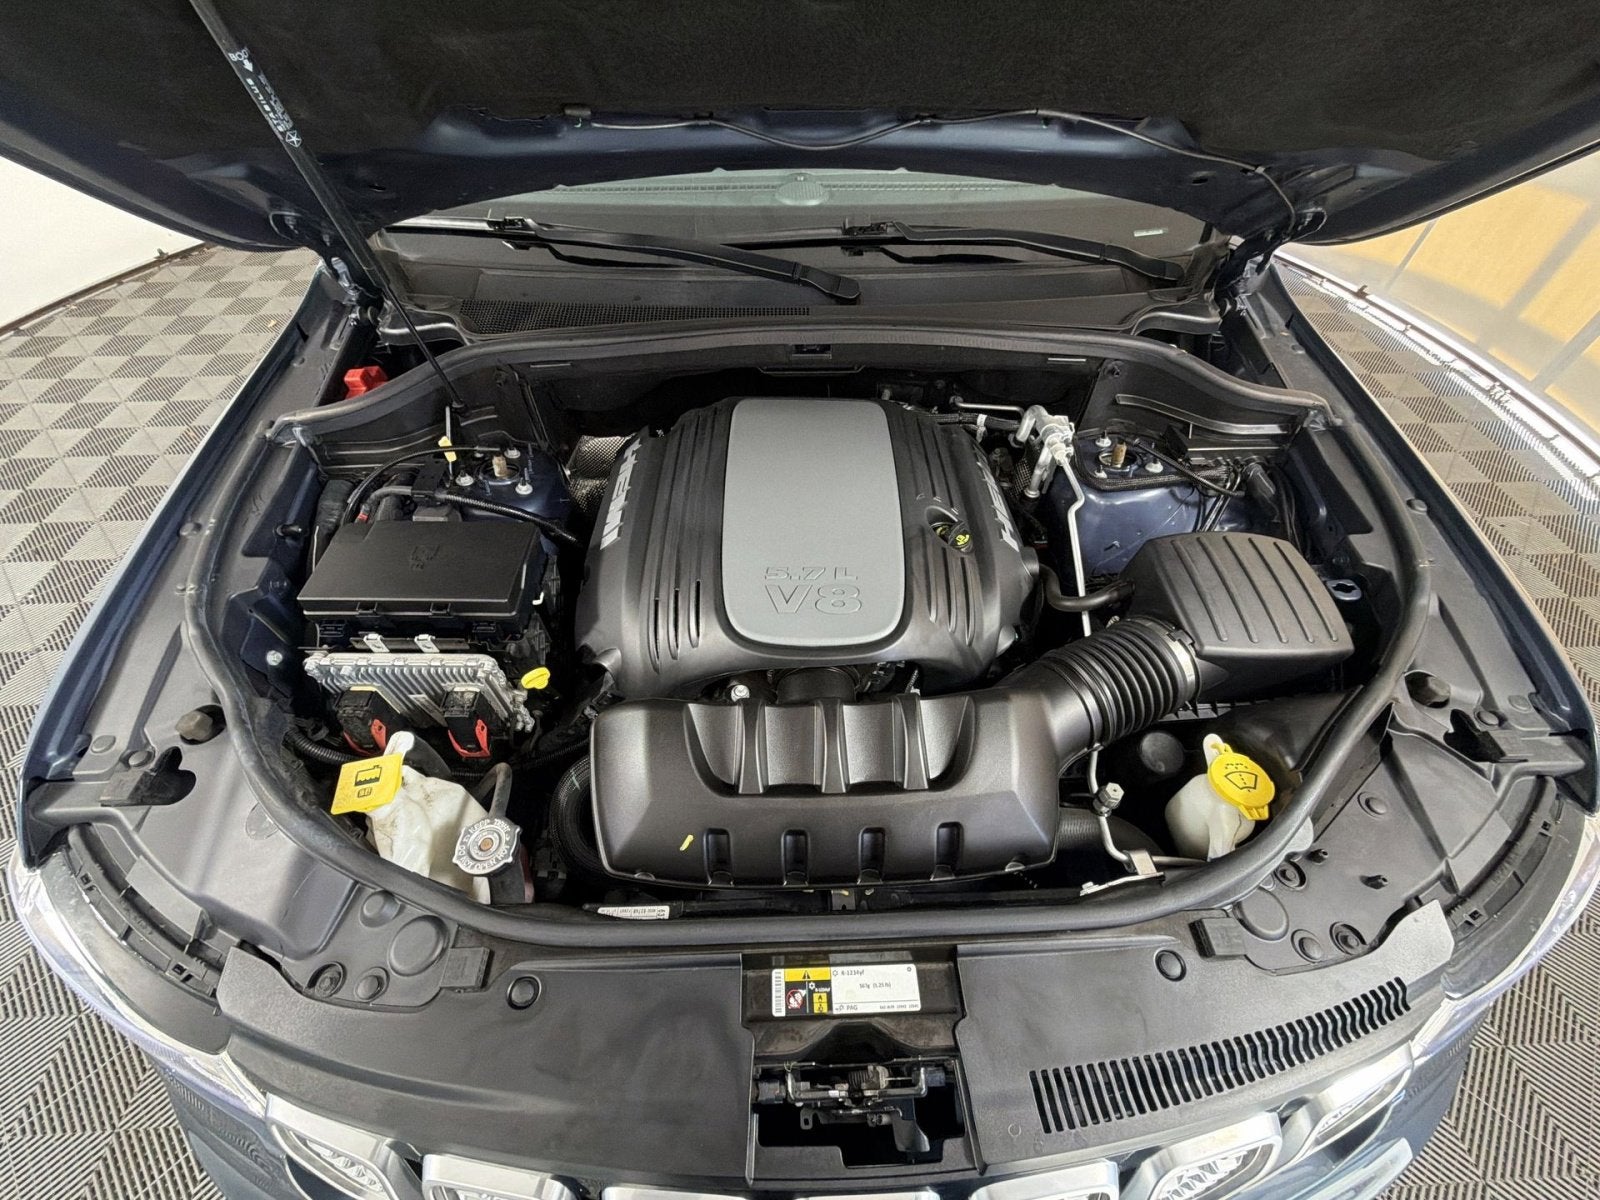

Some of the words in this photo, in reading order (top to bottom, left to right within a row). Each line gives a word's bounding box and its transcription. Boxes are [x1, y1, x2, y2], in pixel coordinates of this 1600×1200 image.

[600, 437, 642, 550] HEMI
[765, 566, 827, 580] 5.7
[765, 584, 863, 615] V8
